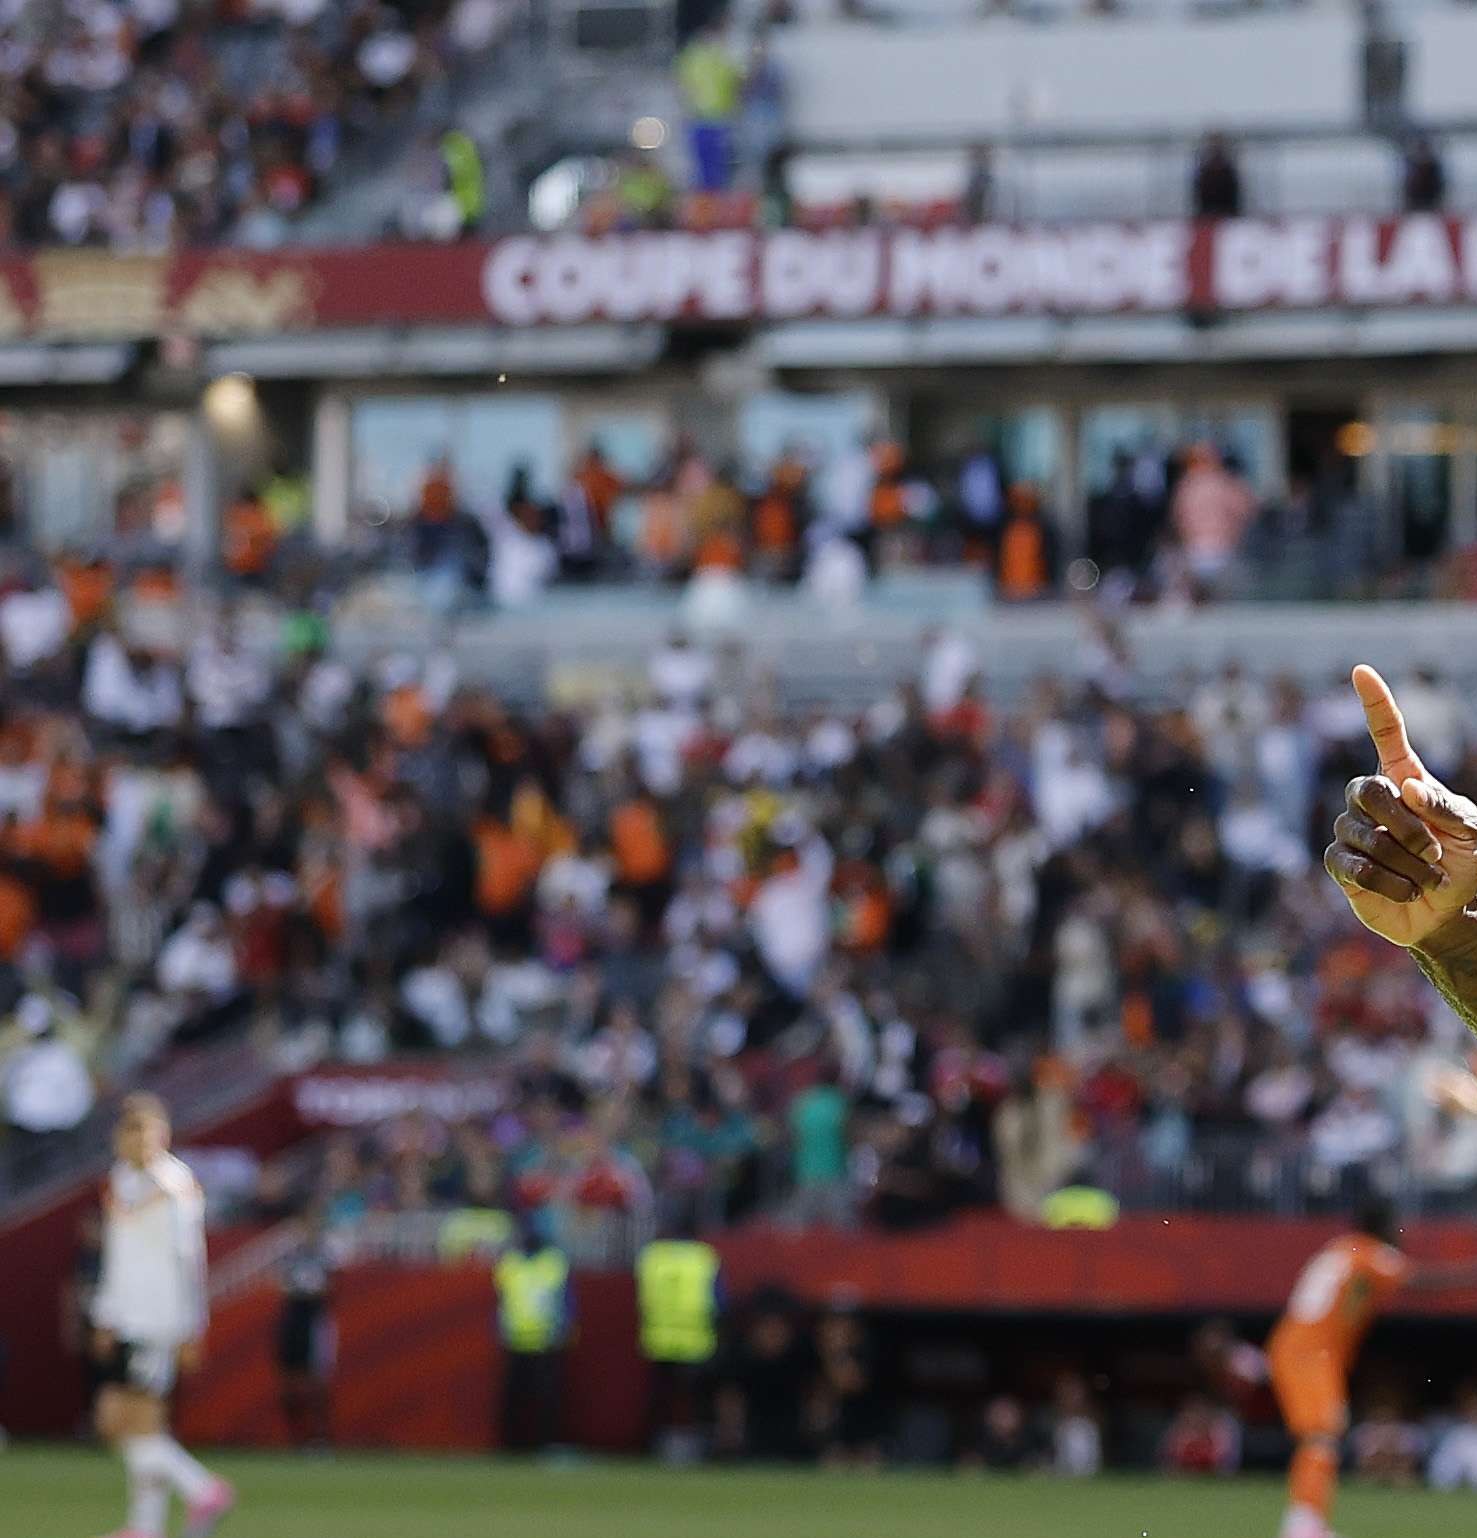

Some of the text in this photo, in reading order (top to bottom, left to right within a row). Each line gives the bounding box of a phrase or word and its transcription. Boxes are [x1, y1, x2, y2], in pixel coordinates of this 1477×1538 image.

[482, 228, 755, 324] COUPE
[764, 225, 883, 316] DU
[892, 221, 1187, 313] MONDE
[1215, 217, 1327, 305] DE
[1341, 213, 1455, 302] LA
